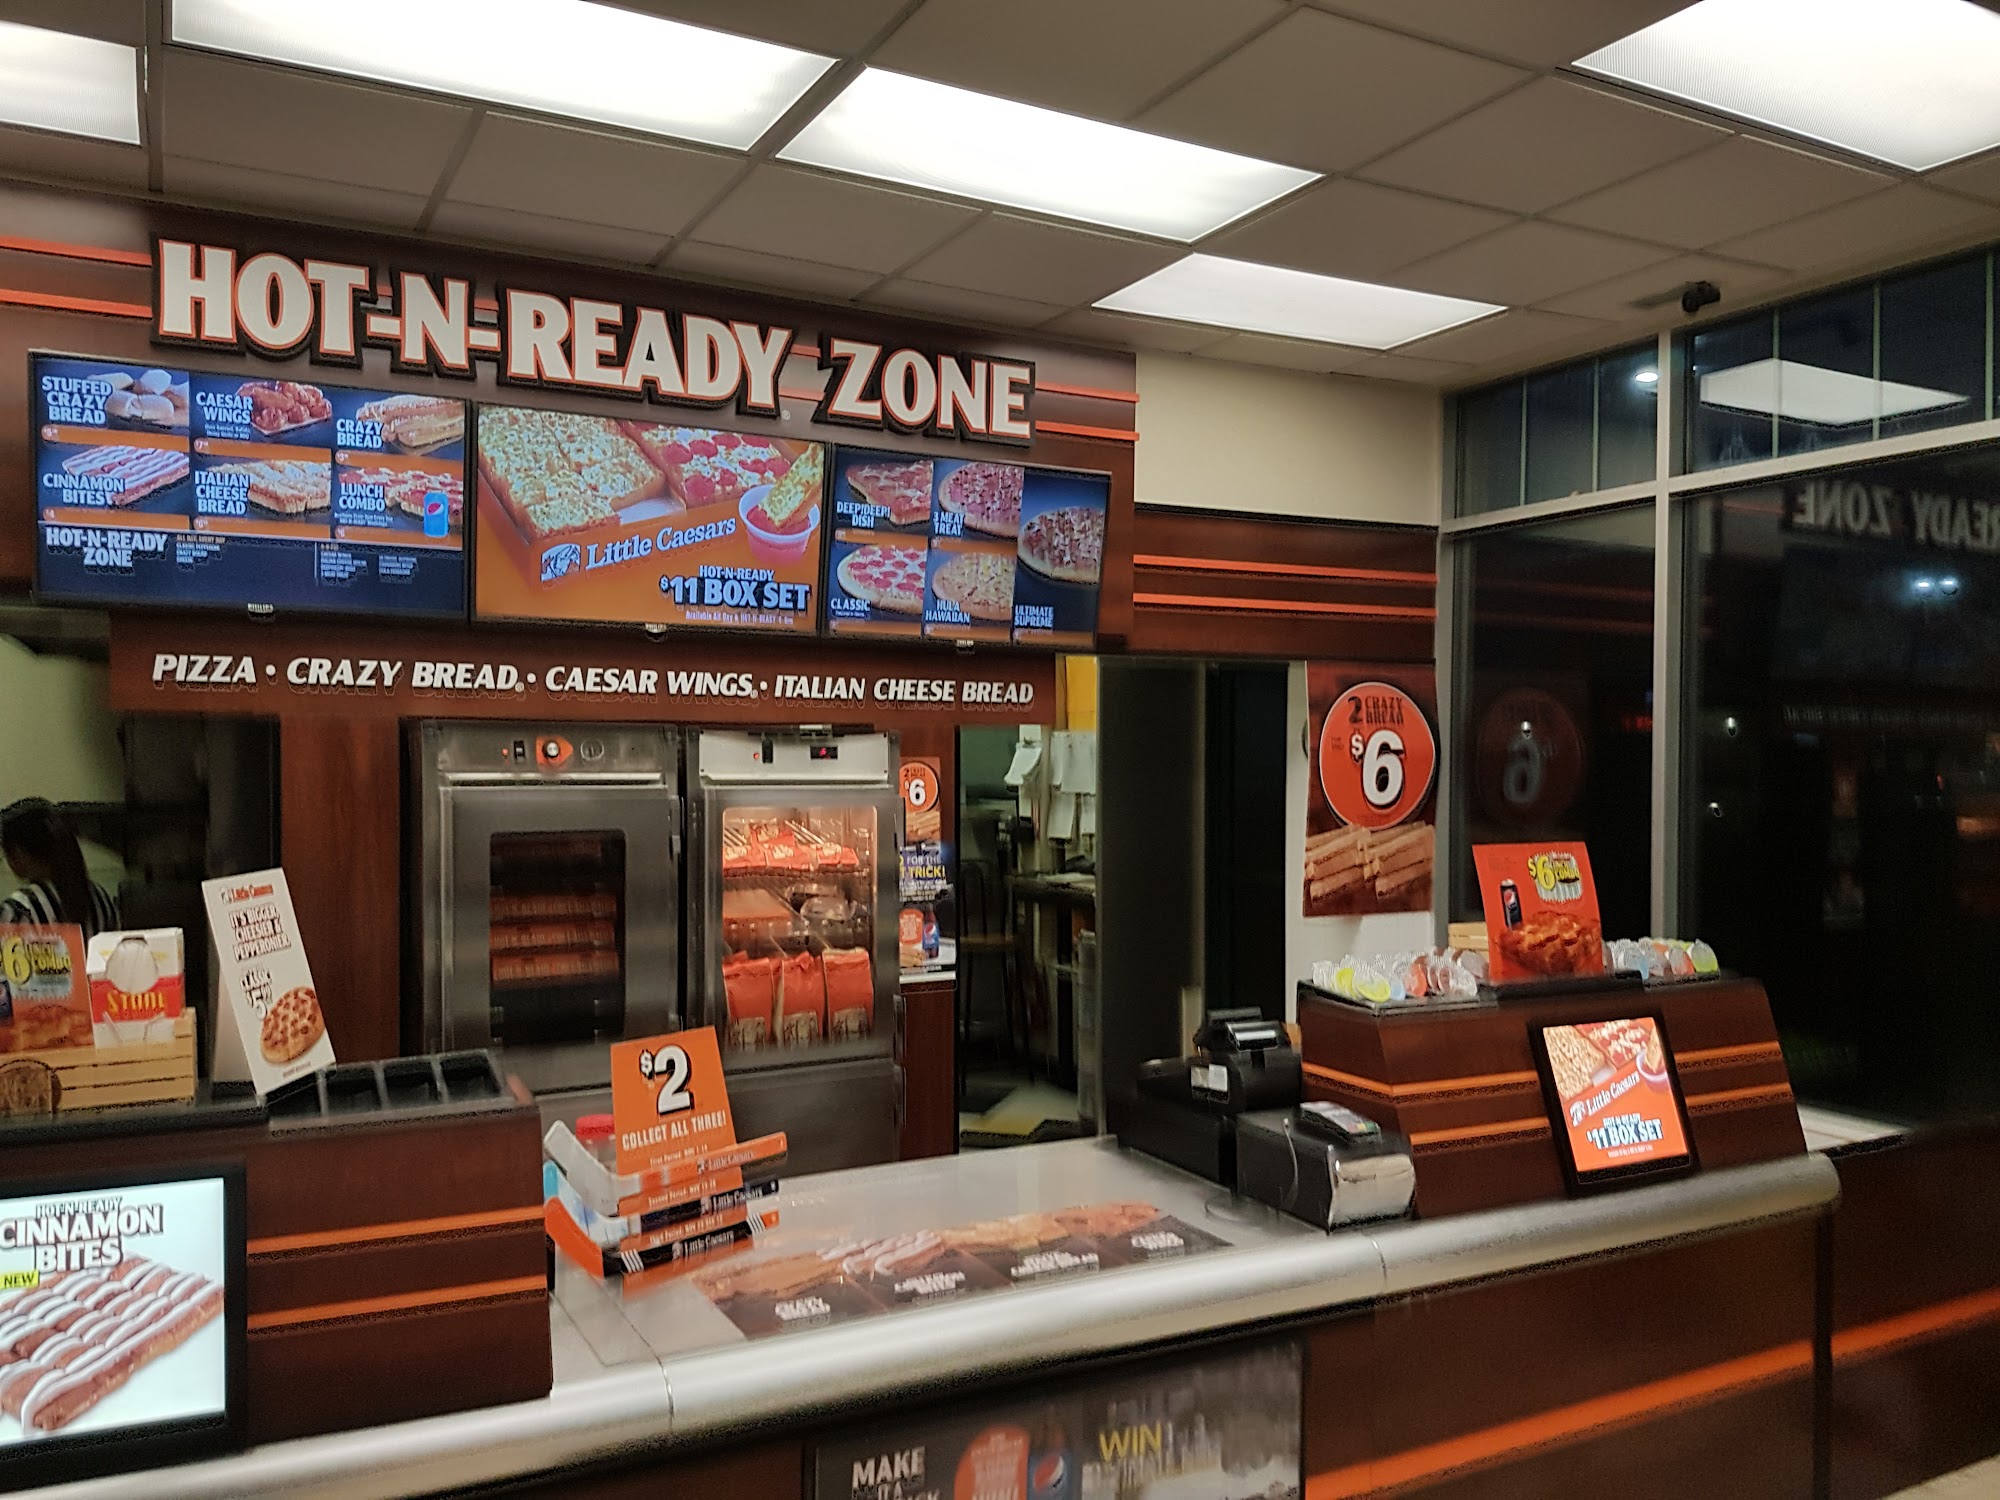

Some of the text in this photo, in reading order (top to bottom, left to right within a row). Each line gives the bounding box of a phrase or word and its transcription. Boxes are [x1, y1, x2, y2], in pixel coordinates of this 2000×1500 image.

[158, 237, 1032, 439] HOT-N-READY ZONE
[42, 375, 112, 396] STUFFED
[46, 391, 107, 410] CRAZY
[196, 391, 253, 411] CAESAR
[48, 406, 106, 424] BREAD
[203, 406, 251, 424] WINGS
[336, 418, 383, 436] CRAZY
[337, 431, 383, 449] BREAD
[43, 472, 125, 493] CINNAMON
[194, 470, 249, 488] ITALIAN
[62, 489, 106, 506] BITES
[195, 485, 248, 501] CHEESE
[340, 482, 384, 499] LUNCH
[198, 498, 246, 515] BREAD
[338, 495, 386, 512] COMBO
[851, 513, 875, 529] DISH
[933, 511, 965, 525] 3 MEAT
[934, 521, 962, 536] TREAT
[46, 526, 168, 552] HOT-N-READY
[585, 517, 737, 571] Little Caesars
[83, 546, 133, 568] ZONE
[699, 564, 776, 582] HOT-N-READY
[659, 574, 811, 611] $11 BOX SET
[830, 597, 871, 612] CLASSIC
[1014, 604, 1054, 617] ULTIMATE
[1014, 615, 1054, 628] SUPREME
[152, 653, 257, 684] PIZZA
[287, 657, 403, 688] CRAZY
[545, 666, 659, 694] CAESAR
[774, 674, 865, 700] ITALIAN
[873, 677, 956, 702] CHEESE
[962, 680, 1035, 704] BREAD
[1347, 695, 1403, 725] 2 CRAZY
[1351, 729, 1405, 807] $6
[906, 855, 923, 866] FOR
[908, 864, 946, 879] TRICK!
[1527, 855, 1557, 891] $6
[229, 908, 247, 929] IT'S
[639, 1044, 693, 1115] $2
[1585, 1070, 1641, 1117] Little Caesars
[622, 1109, 728, 1152] COLLECT ALL THREE!
[1607, 1123, 1639, 1148] BOX
[1638, 1118, 1664, 1143] SET
[35, 1196, 123, 1218] HOT-N-READY
[712, 1186, 763, 1211] Little Caesars
[0, 1203, 163, 1250] CINNAMON
[684, 1230, 735, 1255] Little Caesars
[35, 1236, 123, 1273] BITES
[3, 1271, 36, 1288] NEW
[1100, 1419, 1163, 1463] WIN
[851, 1446, 926, 1491] MAKE
